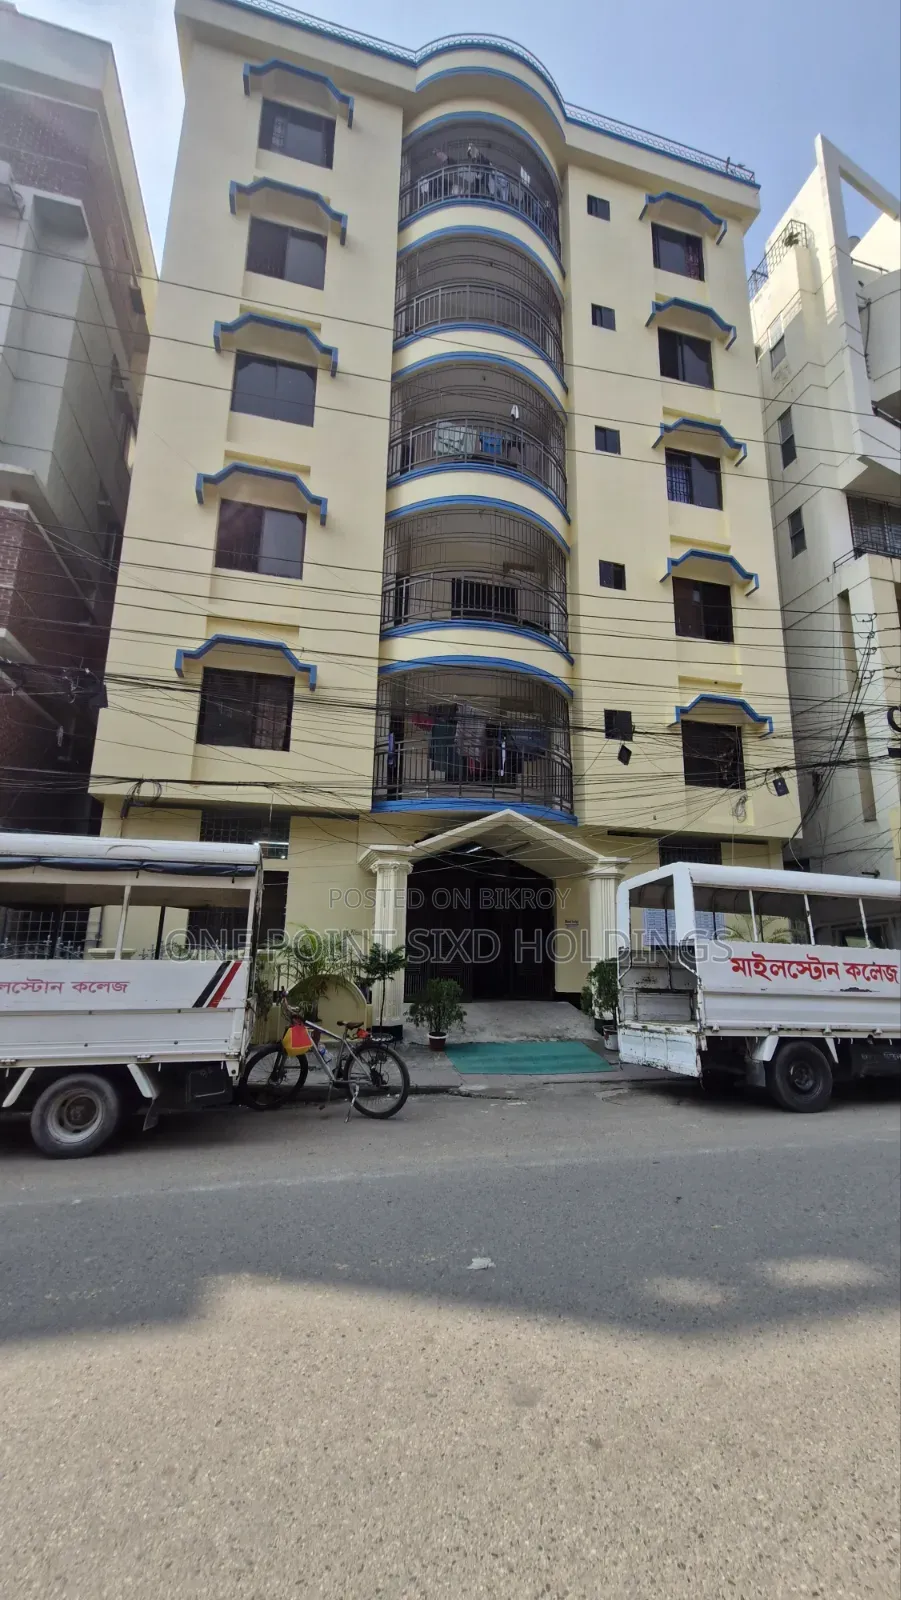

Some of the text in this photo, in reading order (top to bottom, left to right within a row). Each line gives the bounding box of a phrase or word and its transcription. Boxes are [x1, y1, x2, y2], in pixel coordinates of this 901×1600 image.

[729, 951, 900, 984] মাইলস্টোন কলেজ
[71, 981, 130, 994] কলেজ
